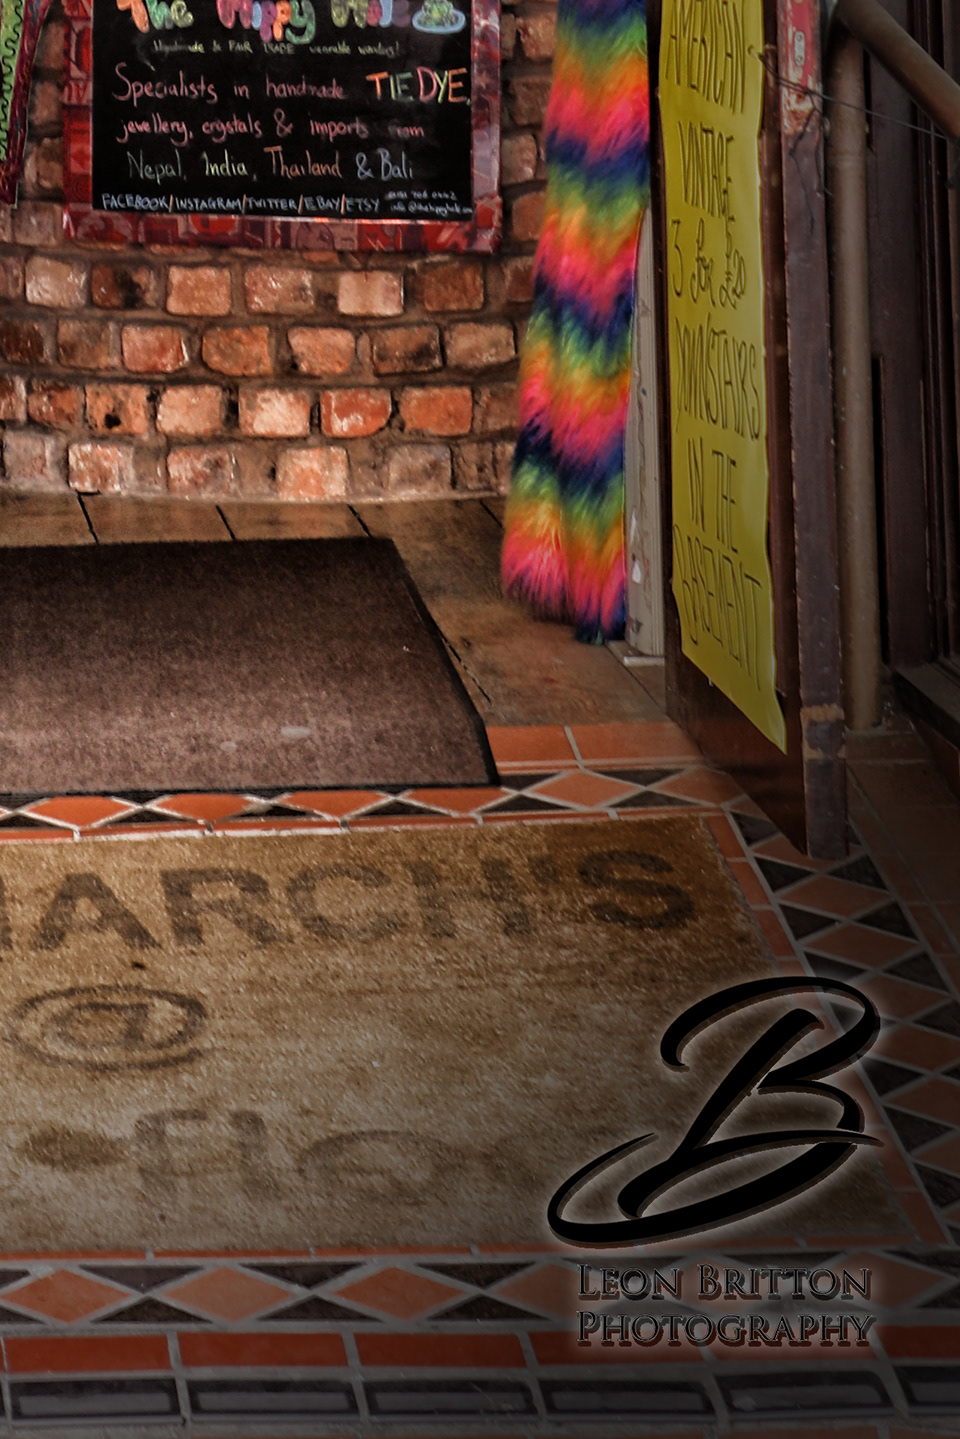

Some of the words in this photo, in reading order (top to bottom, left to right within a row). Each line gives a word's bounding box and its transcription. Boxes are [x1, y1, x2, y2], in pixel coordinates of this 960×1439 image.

[112, 61, 218, 107] Specialists
[234, 80, 250, 100] in
[201, 112, 263, 144] crystals
[273, 107, 294, 138] &
[308, 111, 369, 144] imports
[388, 120, 425, 140] rom
[263, 145, 343, 181] Thailand
[355, 151, 374, 181] &
[377, 148, 414, 182] Bali
[677, 120, 736, 223] VINTAGE
[671, 218, 683, 299] 3
[718, 223, 748, 310] £20
[674, 312, 763, 442] DOWNSTAIRS
[687, 436, 705, 532] IN
[711, 449, 739, 555] THE
[672, 522, 763, 691] BASEMENT
[3, 983, 208, 1074] @
